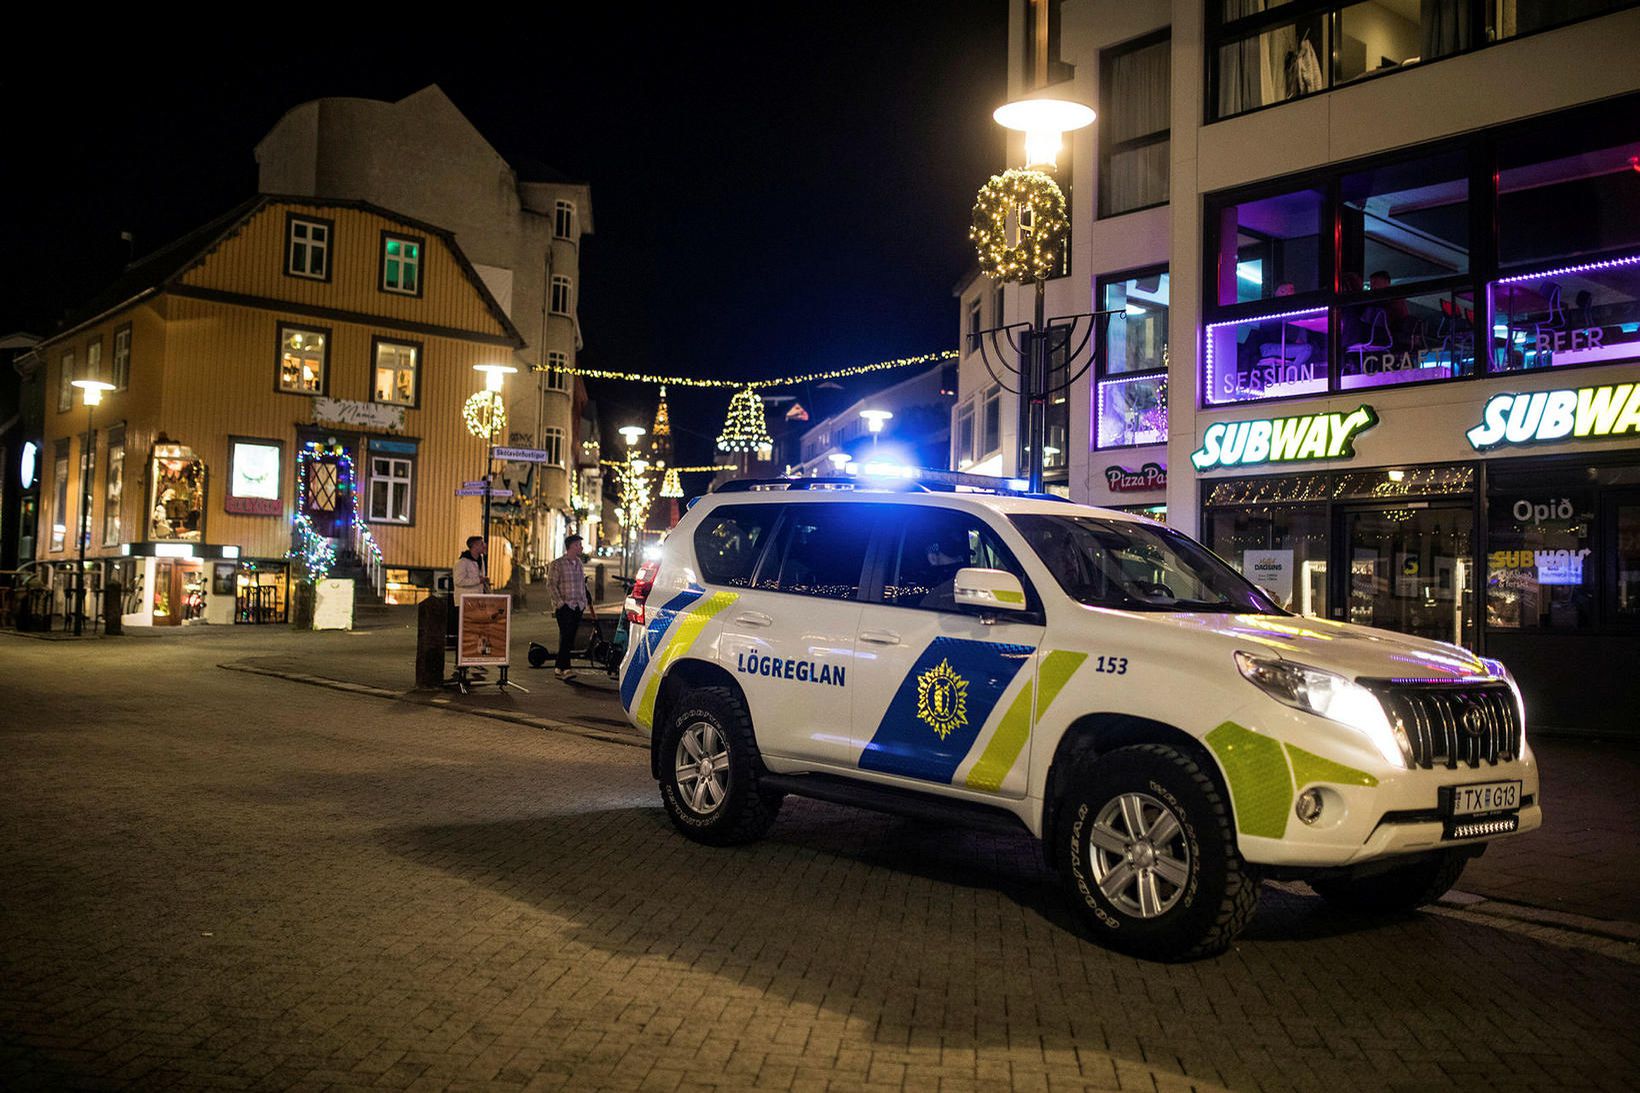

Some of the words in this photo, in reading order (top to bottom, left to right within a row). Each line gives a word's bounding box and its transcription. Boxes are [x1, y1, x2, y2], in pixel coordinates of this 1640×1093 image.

[1223, 363, 1315, 395] SESSION
[1362, 347, 1443, 377] CRAFT
[1536, 326, 1604, 356] BEER
[1108, 470, 1145, 488] Pizza
[1145, 467, 1167, 486] Pa
[1513, 499, 1574, 525] Opið
[738, 649, 846, 687] LÖGREGLAN
[1096, 655, 1128, 675] 153
[1465, 788, 1483, 810] TX
[1493, 785, 1516, 807] G13
[1071, 803, 1121, 929] GOODYEAR
